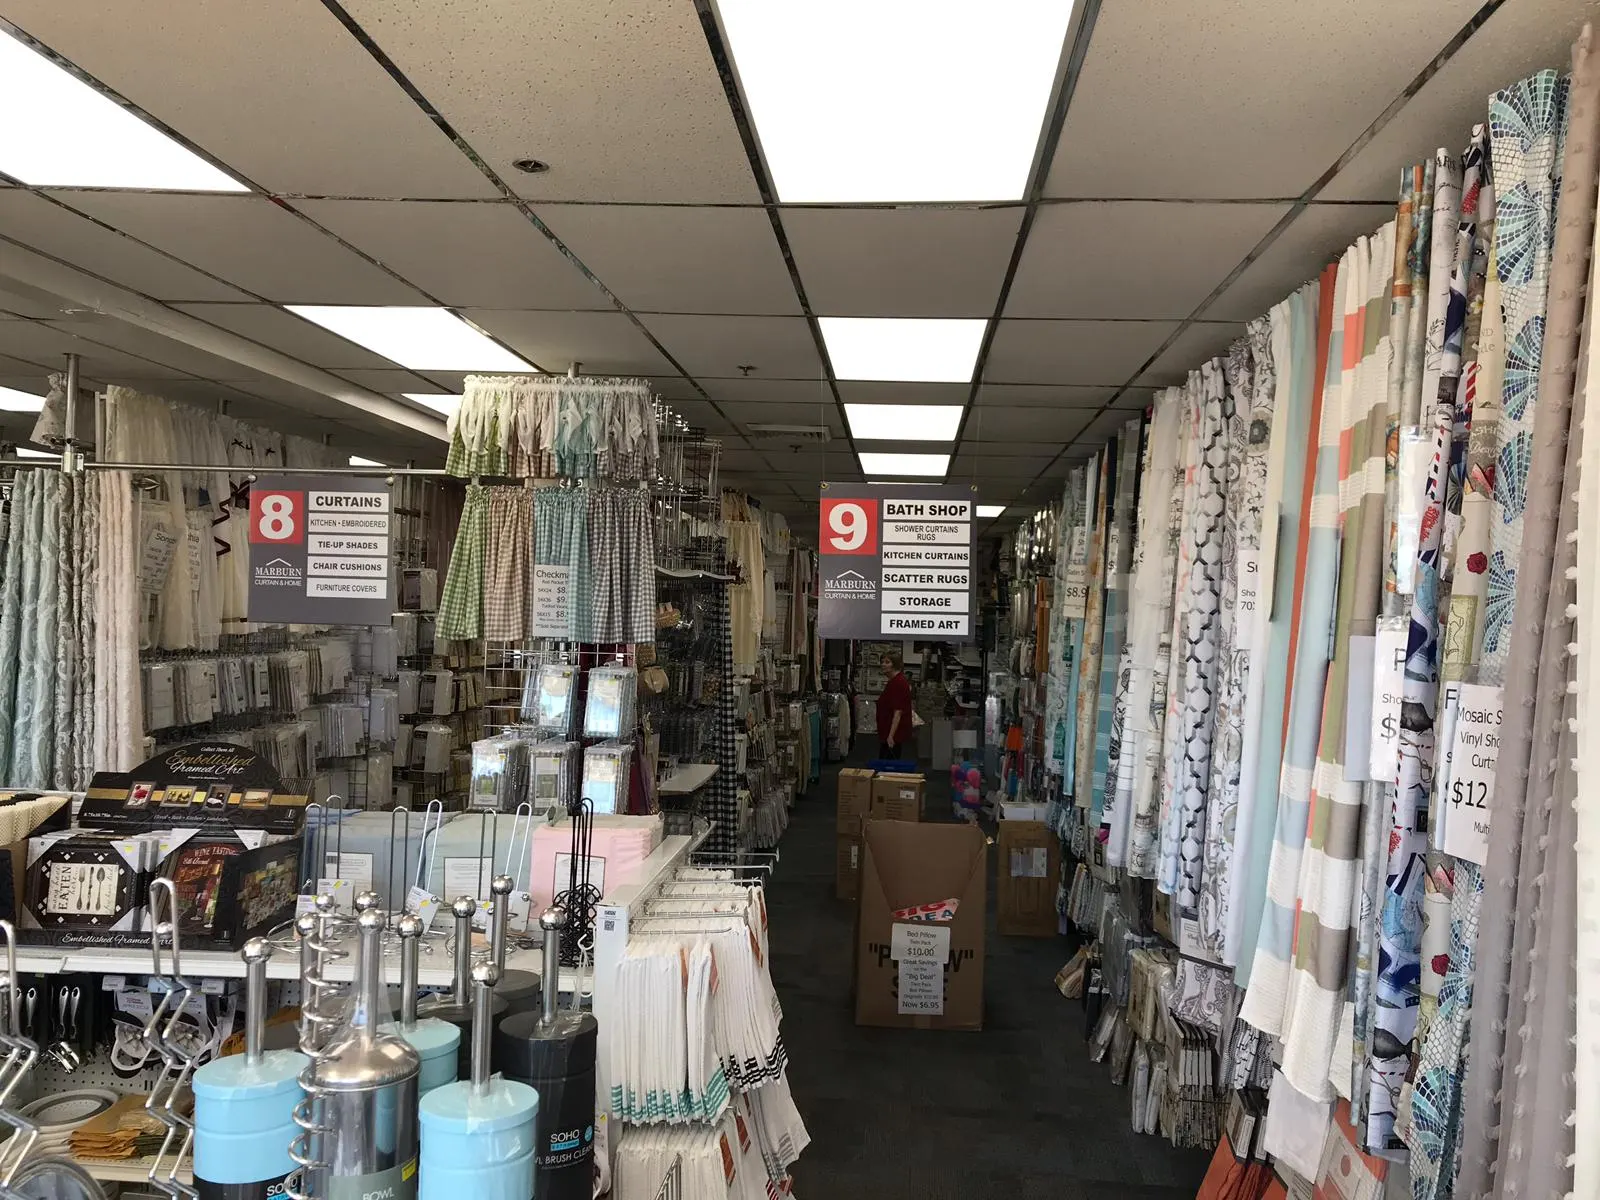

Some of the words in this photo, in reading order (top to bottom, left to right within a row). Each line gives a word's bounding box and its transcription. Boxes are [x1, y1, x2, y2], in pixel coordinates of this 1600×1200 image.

[315, 495, 382, 508] CURTAINS
[886, 504, 924, 516] BATH
[928, 504, 968, 516] SHOP
[259, 494, 295, 540] 8
[310, 518, 337, 527] KITCHEN
[341, 519, 387, 528] EMBROIDERED
[828, 502, 868, 551] 9
[894, 525, 924, 533] SHOWER
[924, 525, 959, 534] CURTAINS
[916, 533, 936, 541] RUGS
[317, 540, 344, 549] TIE-UP
[346, 541, 378, 550] SHADES
[883, 551, 922, 560] KITCHEN
[924, 552, 969, 561] CURTAINS
[255, 566, 302, 577] MARBURN
[313, 562, 338, 570] CHAIR
[340, 563, 382, 571] CUSHIONS
[254, 578, 279, 586] CURTAIN
[284, 579, 302, 587] HOME
[824, 579, 876, 590] MARBURN
[883, 574, 934, 584] SCATTER
[937, 574, 968, 584] RUGS
[316, 583, 351, 592] FURNITURE
[351, 584, 377, 593] COVERS
[824, 592, 851, 600] CURTAIN
[899, 596, 951, 607] STORAGE
[889, 619, 935, 629] FRAMED
[938, 620, 961, 630] ART
[1457, 706, 1493, 725] Mosaic
[1380, 712, 1397, 744] $
[1460, 731, 1483, 748] Vinyl
[165, 749, 256, 766] Embellished
[170, 761, 215, 773] Framed
[214, 764, 244, 775] Art
[58, 866, 72, 910] EATEN
[61, 932, 114, 944] Embellished
[114, 934, 151, 945] Framed
[919, 1001, 940, 1009] $6.95
[550, 1129, 580, 1143] SOHO
[545, 1152, 572, 1165] BRUSH
[266, 1176, 298, 1197] SOO
